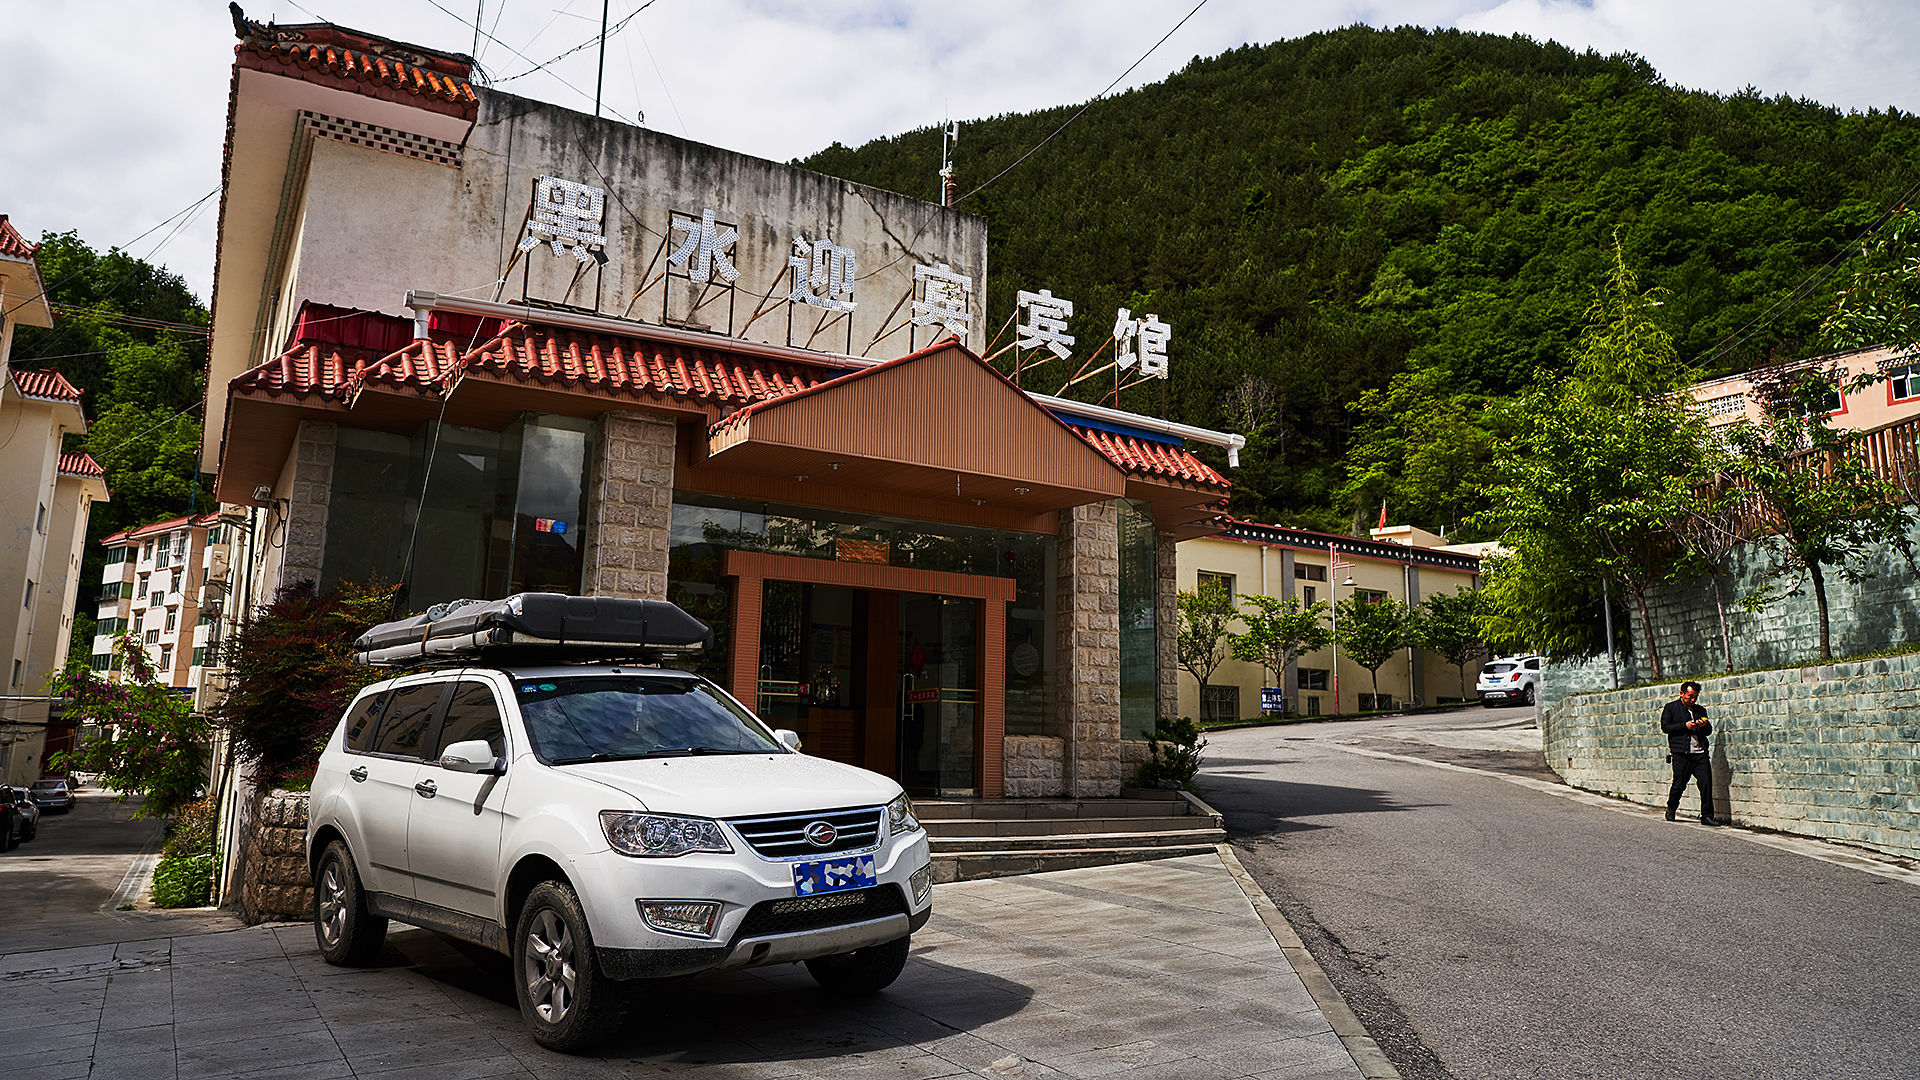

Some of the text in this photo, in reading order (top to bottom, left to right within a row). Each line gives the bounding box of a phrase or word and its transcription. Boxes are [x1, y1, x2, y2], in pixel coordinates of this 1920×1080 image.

[518, 174, 1172, 380] 黑水迎宾宾馆
